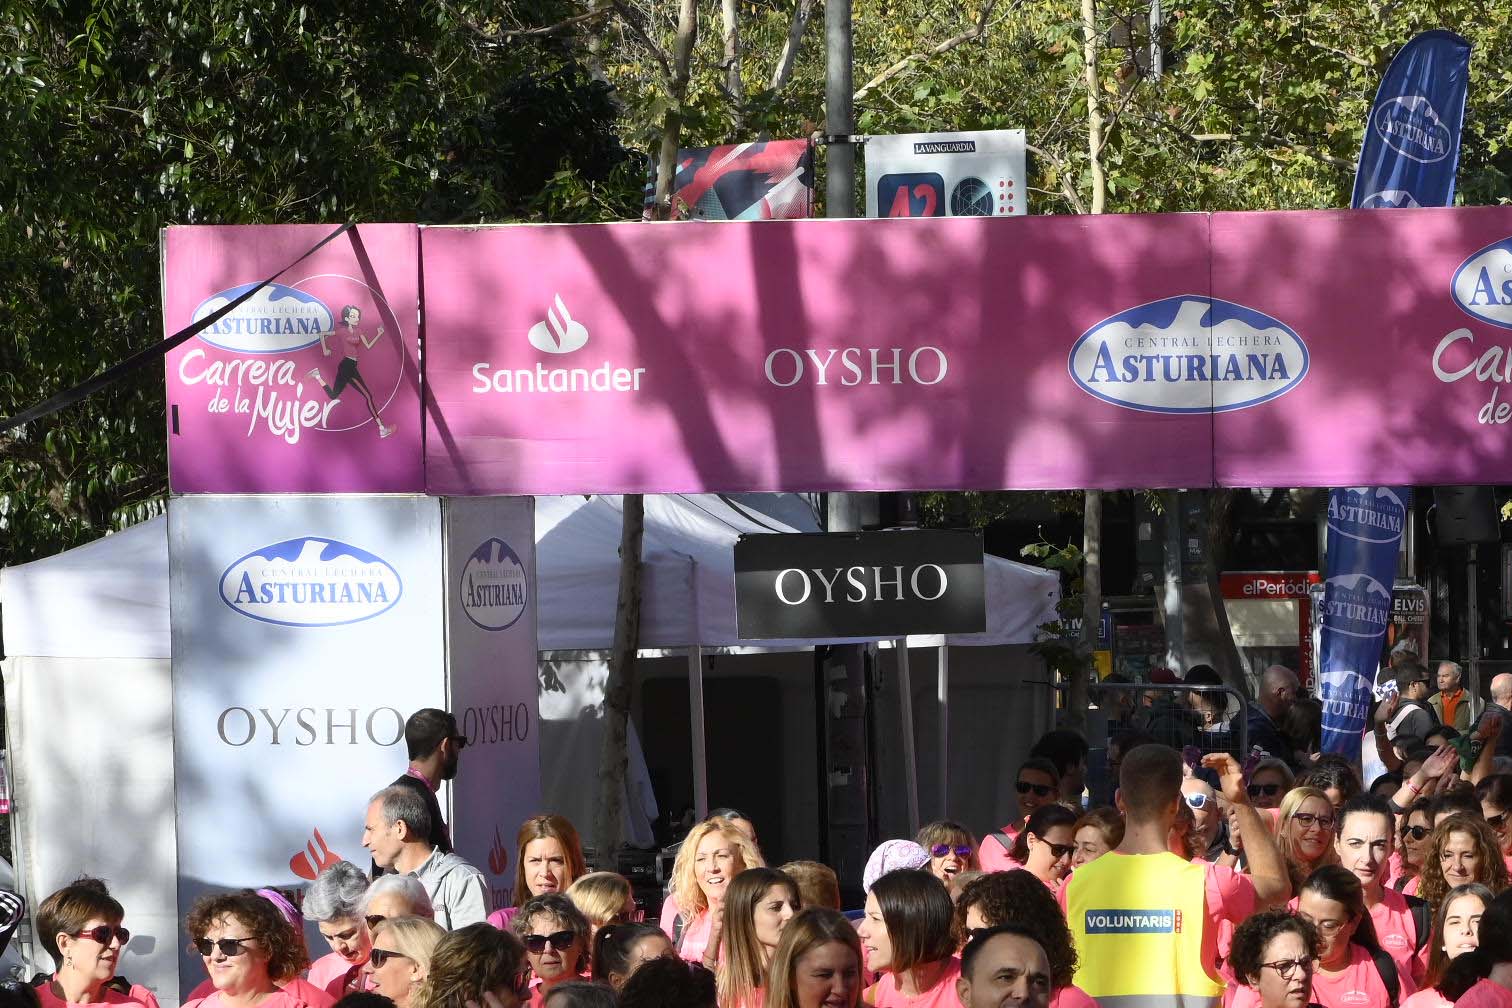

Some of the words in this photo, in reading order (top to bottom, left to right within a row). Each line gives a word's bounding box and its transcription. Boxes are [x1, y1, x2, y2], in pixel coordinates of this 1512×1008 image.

[915, 144, 927, 153] LA
[926, 142, 975, 153] VANGUARDIA
[1124, 337, 1199, 348] CENTRAL
[1206, 335, 1282, 347] LECHERA
[178, 348, 297, 386] Carrera
[472, 360, 646, 394] Santander
[764, 346, 948, 388] OYSHO
[1088, 340, 1290, 383] ASTURIANA
[207, 391, 229, 413] de
[234, 391, 250, 414] la
[248, 382, 341, 445] Mujer
[1478, 386, 1512, 425] de
[1328, 494, 1401, 533] ASTURIANA
[234, 570, 390, 604] ASTURIANA
[465, 572, 525, 608] ASTURIANA
[775, 563, 948, 605] OYSHO
[1243, 579, 1311, 595] elPeriódi
[1394, 598, 1424, 611] ELVIS
[217, 706, 405, 747] OYSHO
[463, 702, 529, 747] OYSHO
[1087, 915, 1172, 928] VOLUNTARIS
